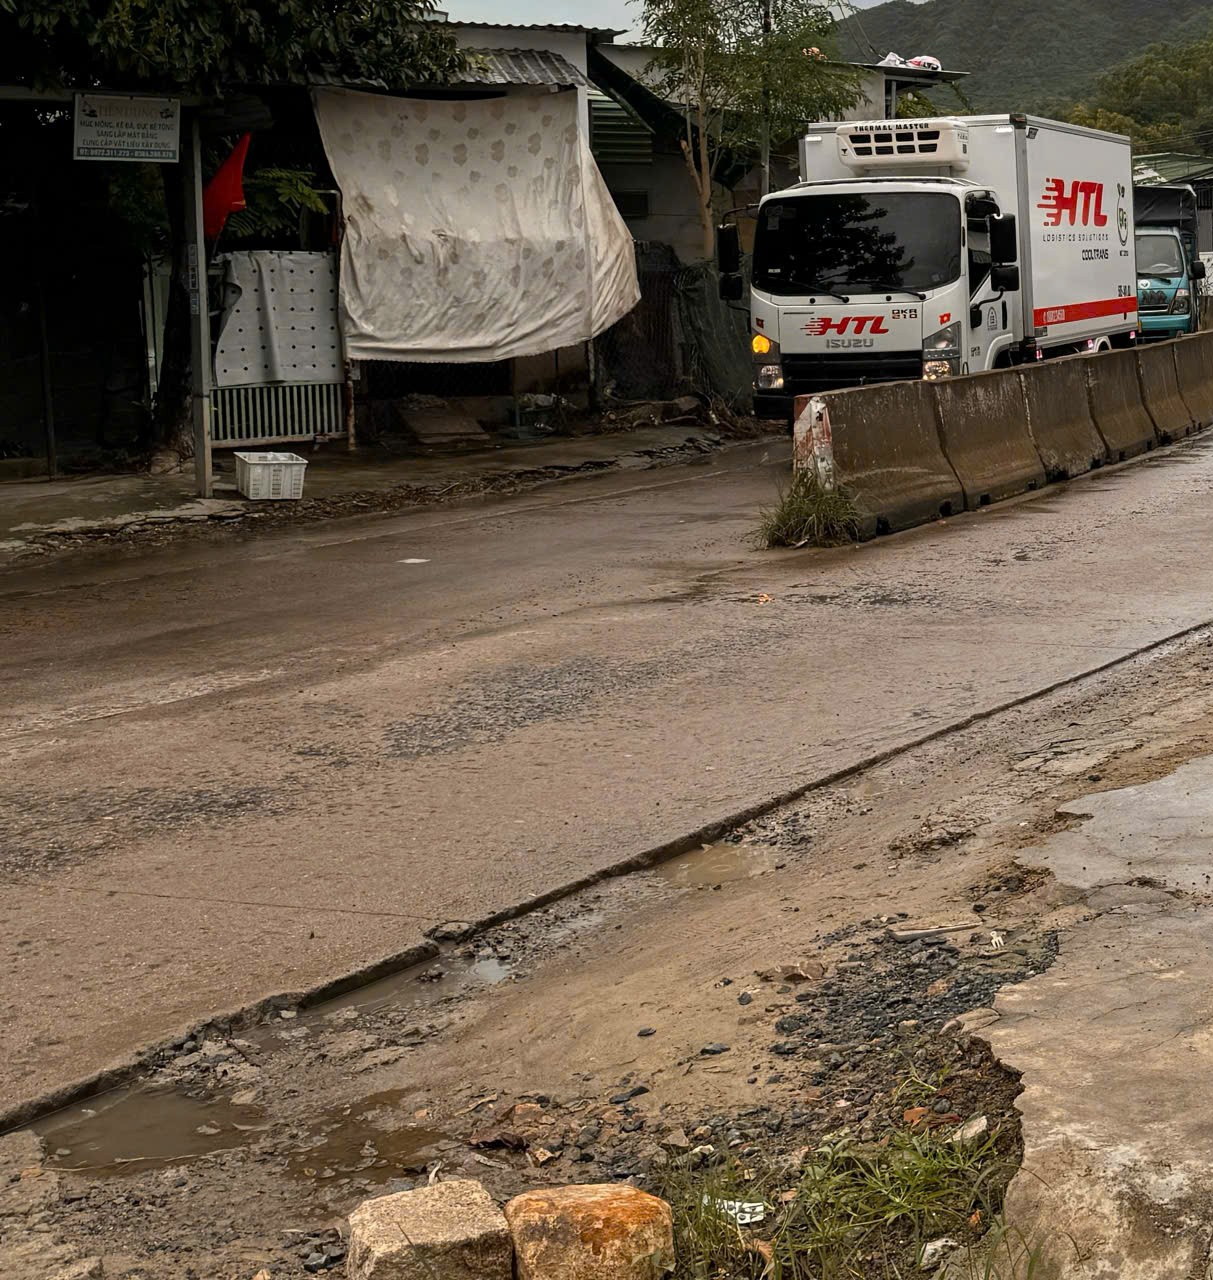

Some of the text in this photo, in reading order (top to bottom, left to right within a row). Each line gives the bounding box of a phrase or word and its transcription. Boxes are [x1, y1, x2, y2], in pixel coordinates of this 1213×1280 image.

[1037, 177, 1108, 227] HTL
[802, 315, 890, 336] HTL
[825, 338, 874, 349] ISUZU
